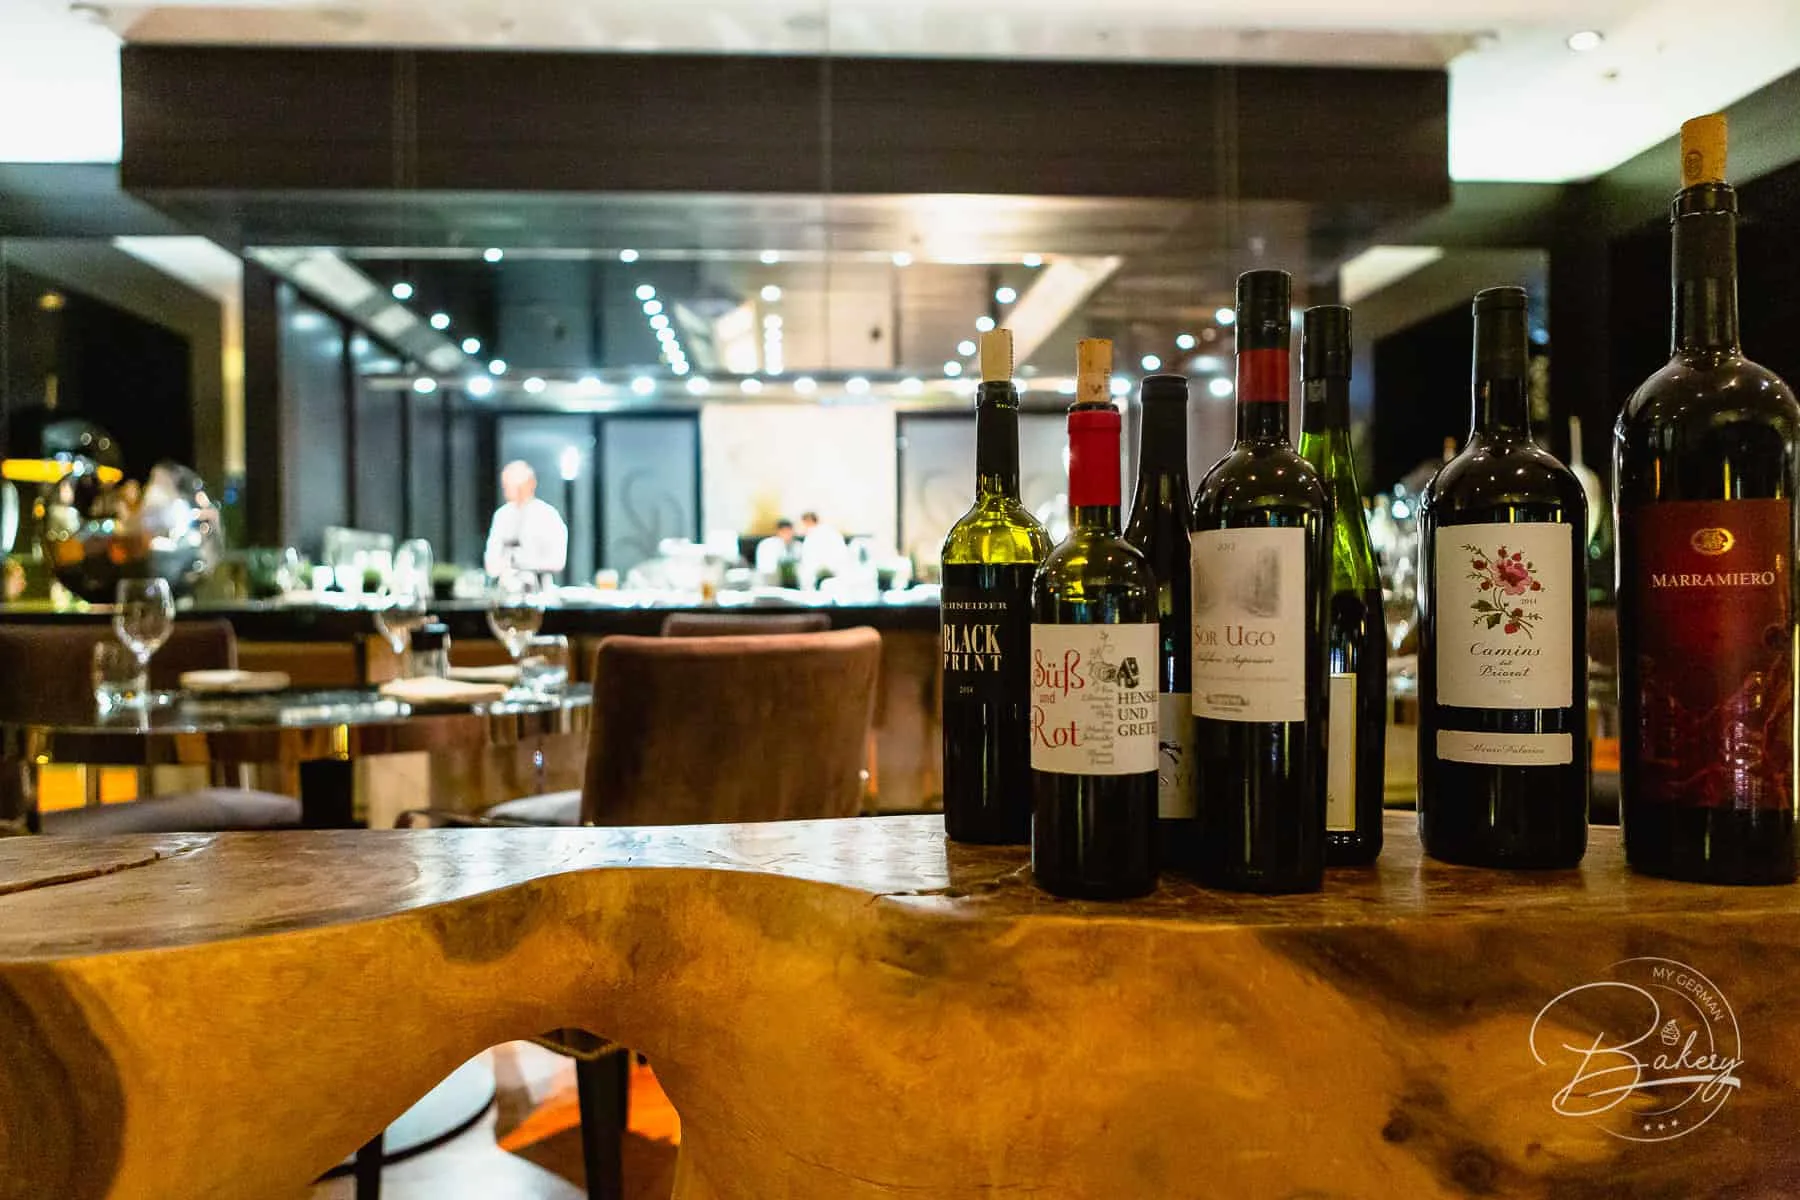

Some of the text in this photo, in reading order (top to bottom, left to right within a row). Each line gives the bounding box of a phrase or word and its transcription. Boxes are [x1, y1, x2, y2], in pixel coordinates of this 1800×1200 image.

[1651, 571, 1776, 588] MARRAMIERO
[943, 623, 1001, 654] BLACK
[1225, 625, 1275, 648] UGO
[1470, 641, 1542, 657] Camins
[943, 653, 1003, 672] PRINT
[1031, 648, 1085, 698] Süß
[1117, 707, 1148, 721] UND
[1030, 704, 1085, 749] Rot
